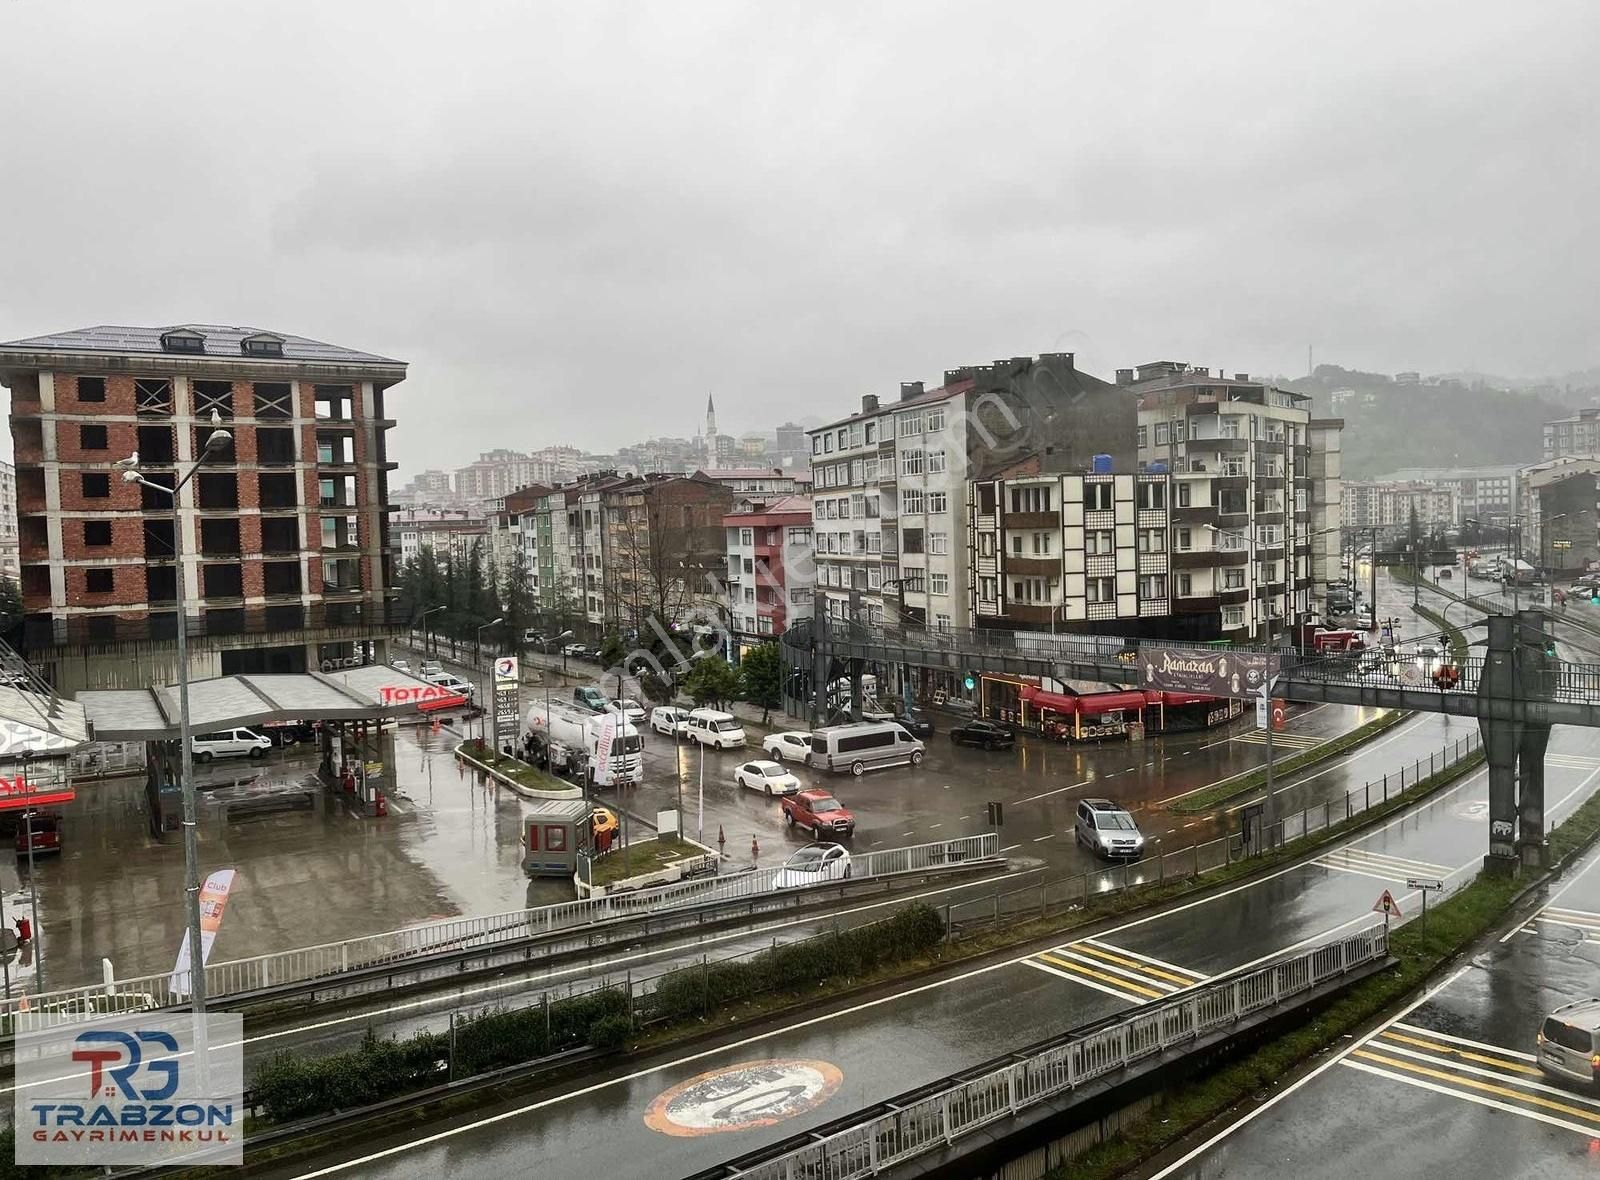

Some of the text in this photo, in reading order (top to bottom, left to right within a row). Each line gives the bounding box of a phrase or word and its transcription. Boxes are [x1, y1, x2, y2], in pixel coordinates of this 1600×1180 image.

[1159, 652, 1216, 676] Ramazan
[380, 685, 451, 702] TOTAL
[598, 724, 614, 773] excellium
[207, 881, 227, 892] Club
